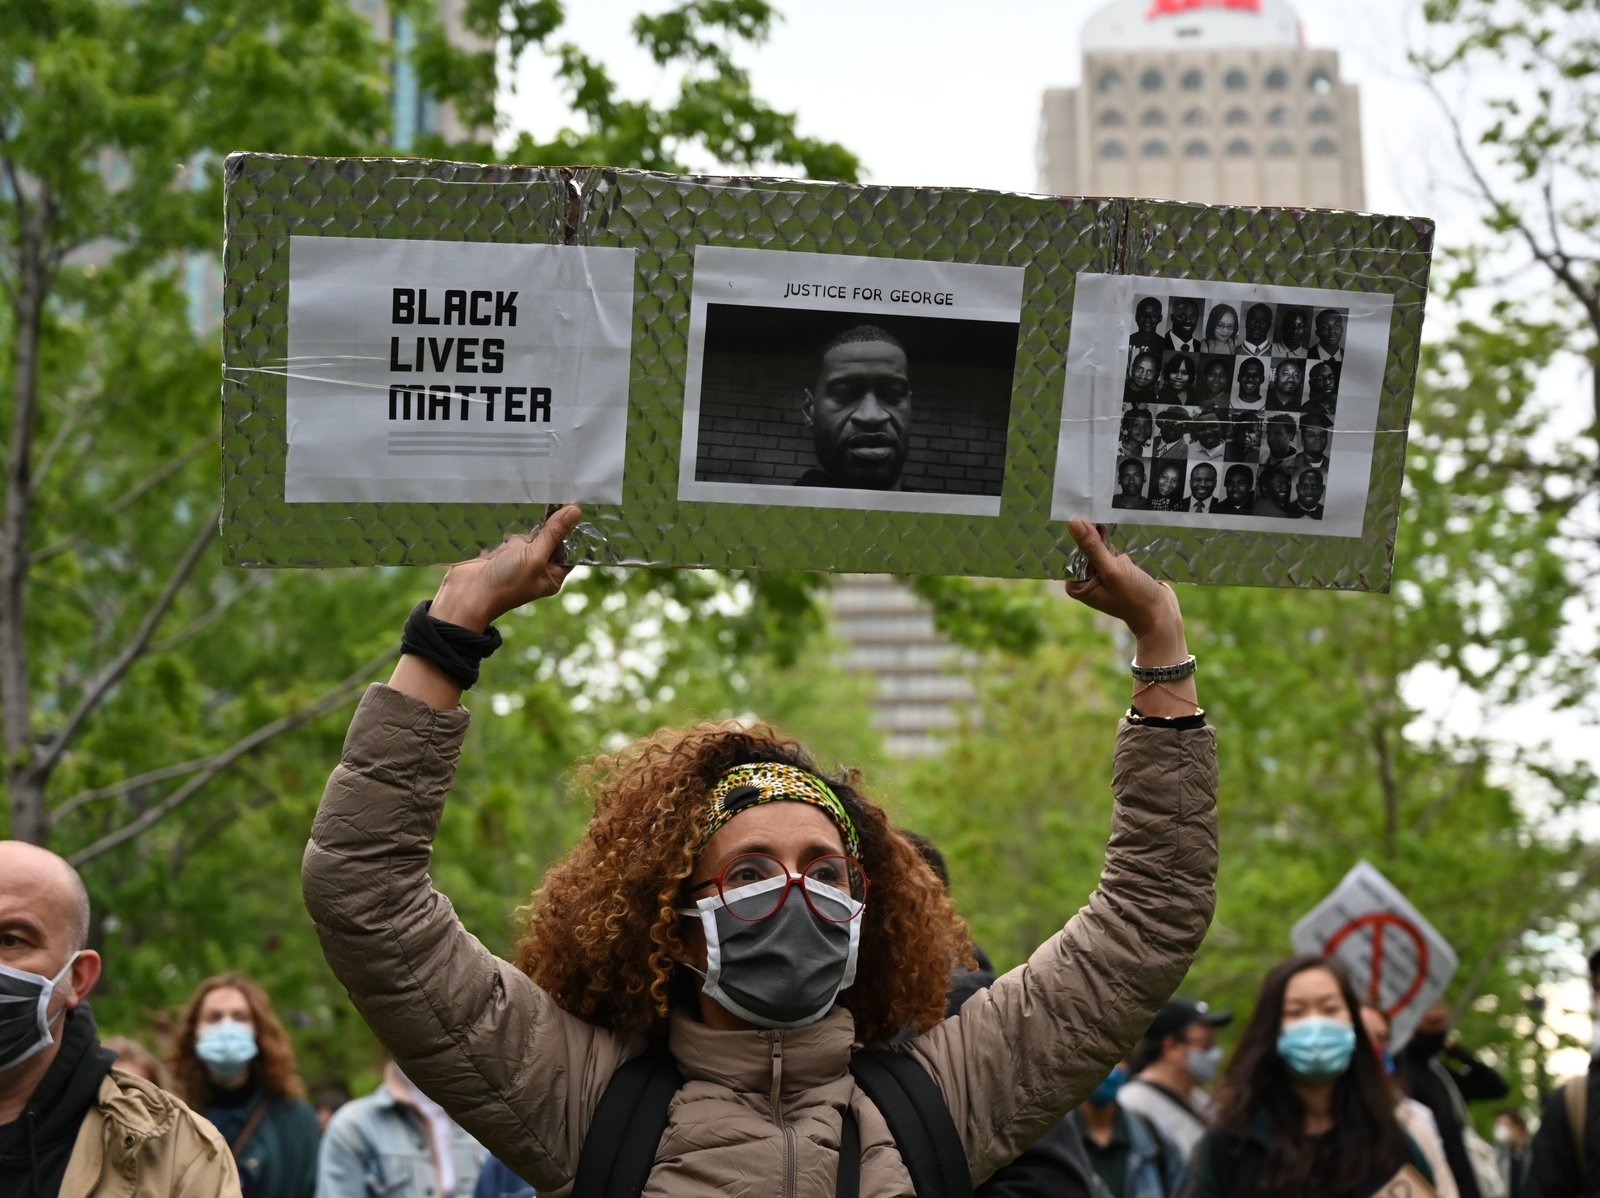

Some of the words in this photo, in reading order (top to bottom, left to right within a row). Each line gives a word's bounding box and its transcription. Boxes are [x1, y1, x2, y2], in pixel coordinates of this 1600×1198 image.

[392, 288, 519, 326] BLACK
[784, 283, 846, 299] JUSTICE
[852, 287, 883, 301] FOR
[890, 289, 954, 306] GEORGE
[389, 336, 505, 374] LIVES
[388, 384, 552, 423] MATTER
